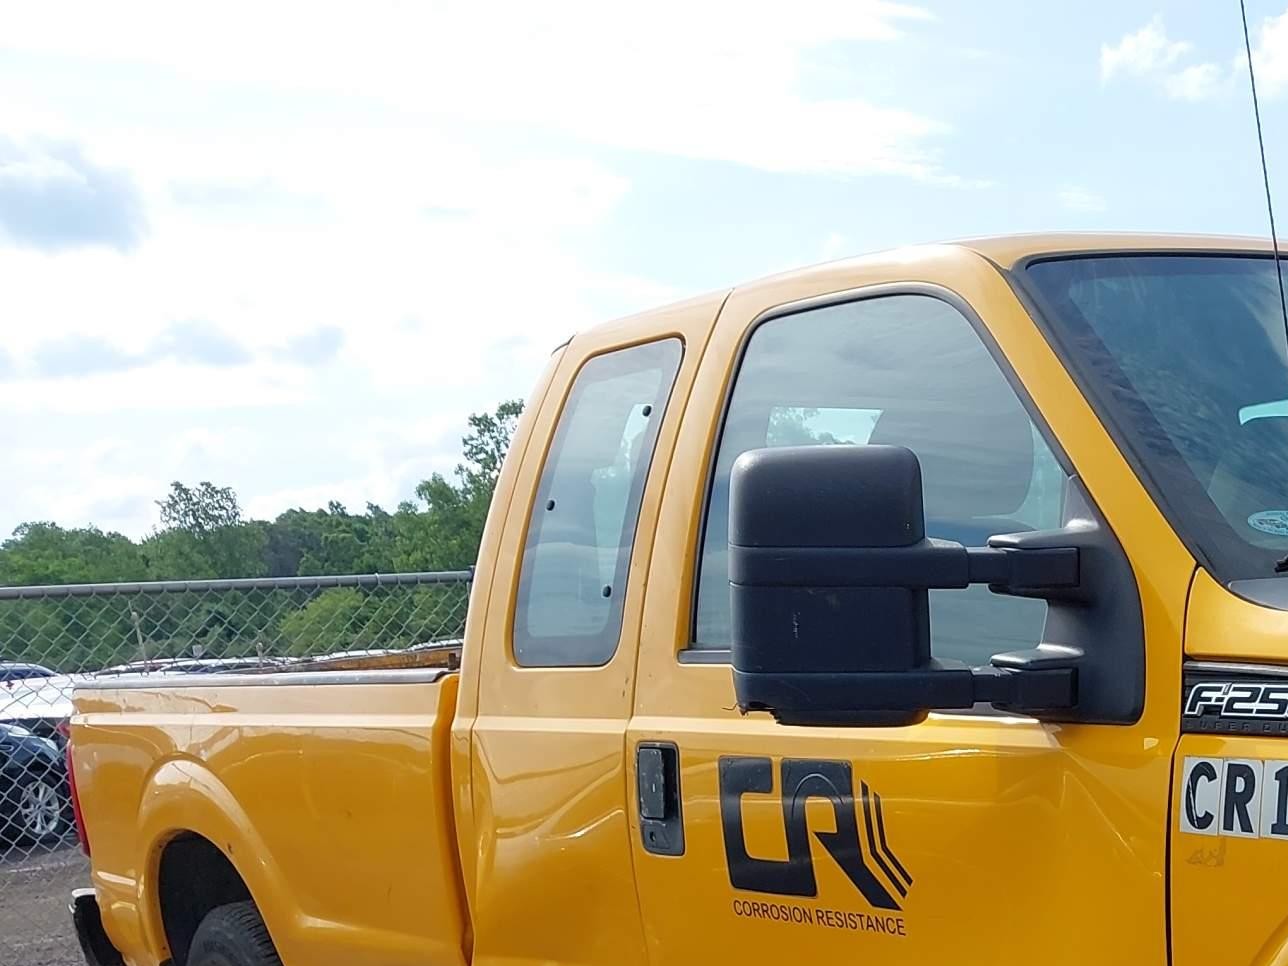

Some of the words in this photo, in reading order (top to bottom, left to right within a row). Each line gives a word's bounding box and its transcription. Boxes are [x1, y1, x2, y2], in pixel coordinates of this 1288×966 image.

[1185, 720, 1250, 732] SUPER
[733, 899, 813, 925] CORROSION
[815, 908, 906, 937] RESISTANCE
